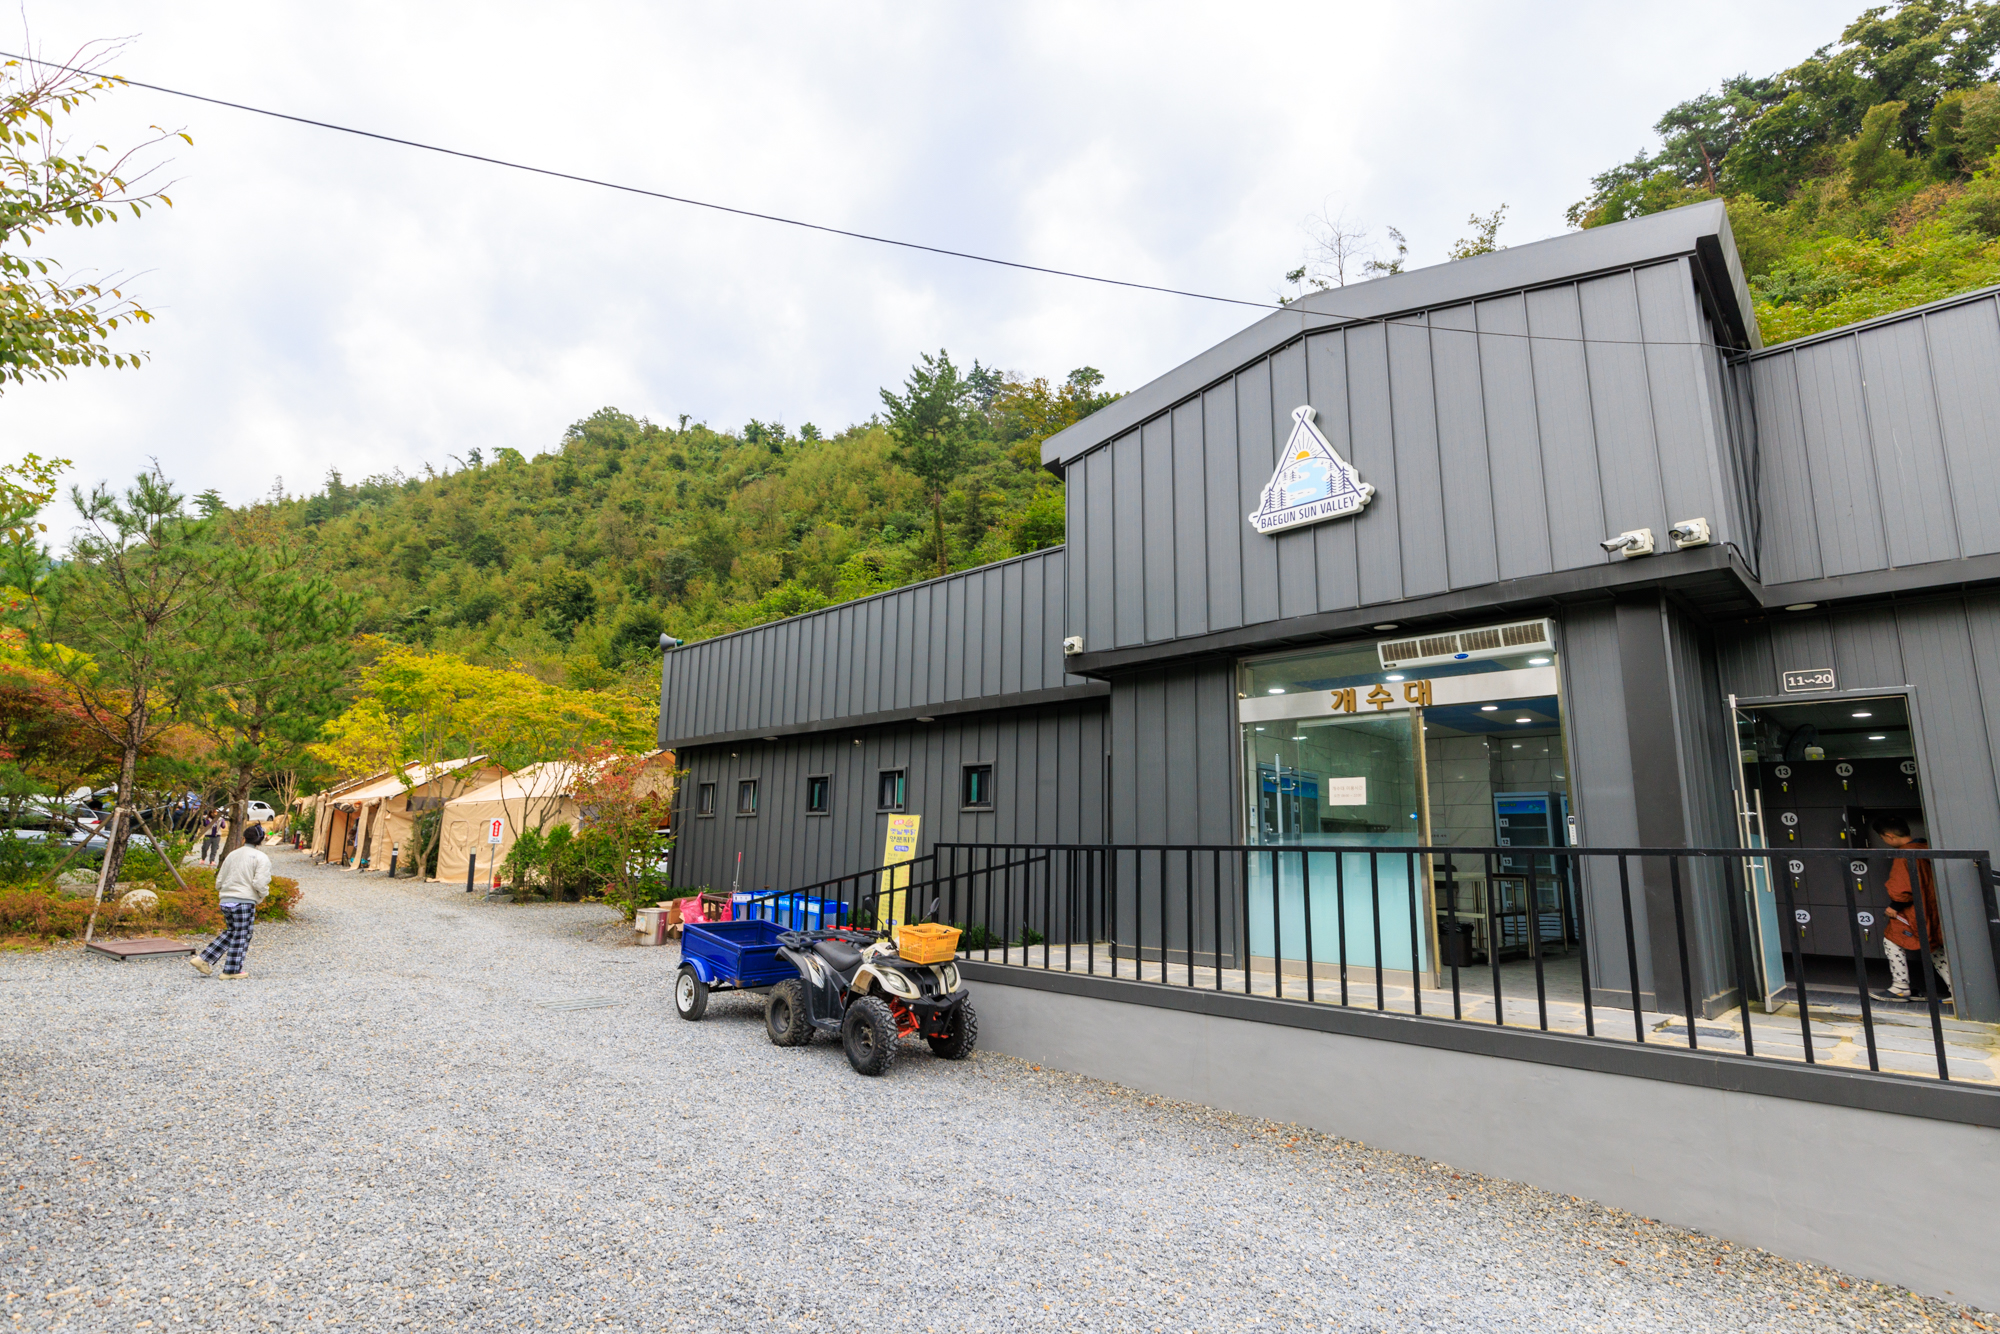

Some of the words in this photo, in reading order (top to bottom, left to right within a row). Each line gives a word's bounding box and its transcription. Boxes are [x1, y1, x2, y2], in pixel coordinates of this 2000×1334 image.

[1261, 510, 1296, 529] BAEGUN
[1299, 504, 1317, 520] SUN
[1320, 495, 1355, 514] VALLEY
[1331, 679, 1432, 713] 개수대
[1838, 766, 1850, 774] 14
[1902, 763, 1916, 772] 15
[1777, 768, 1789, 776] 13
[1783, 815, 1796, 823] 16
[1790, 863, 1802, 871] 19
[1852, 864, 1865, 872] 20
[1860, 915, 1871, 923] 23
